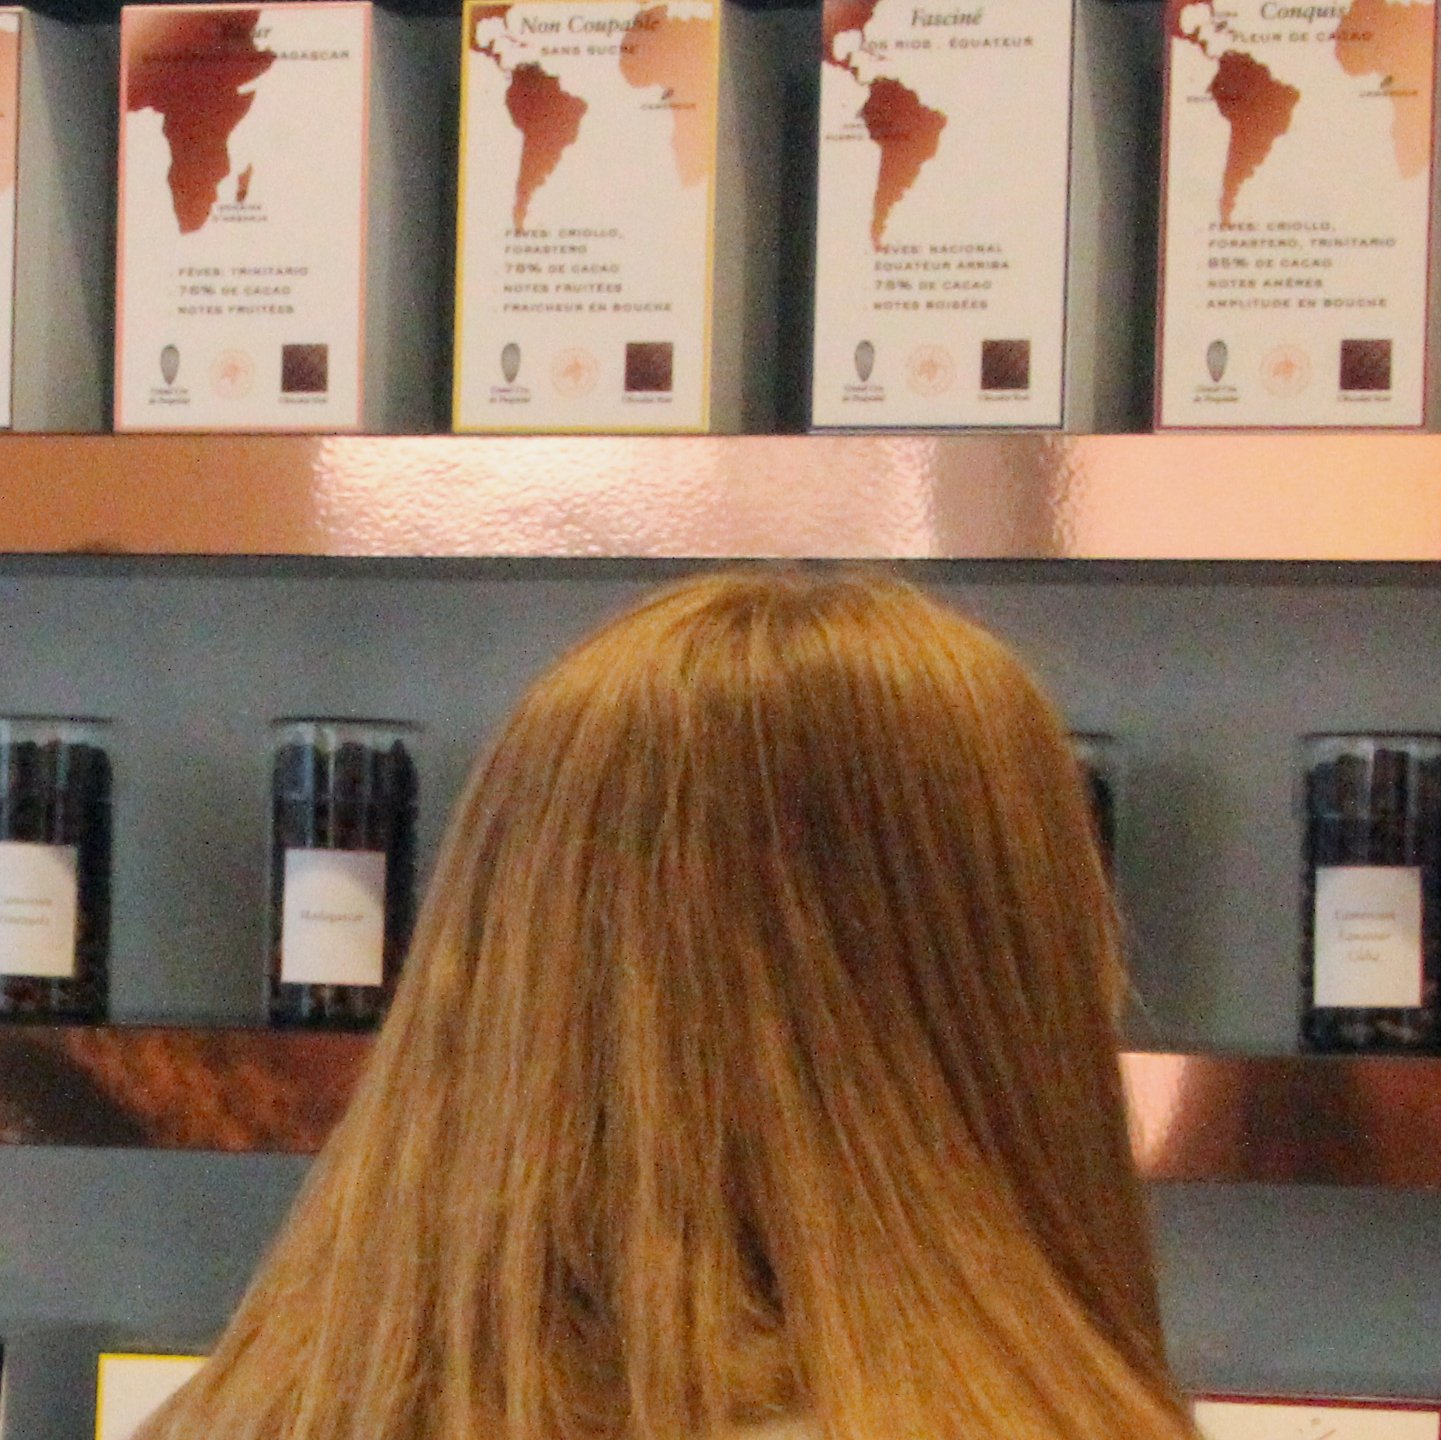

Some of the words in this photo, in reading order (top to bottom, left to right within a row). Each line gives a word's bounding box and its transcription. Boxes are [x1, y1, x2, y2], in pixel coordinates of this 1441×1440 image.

[910, 6, 985, 28] Fasciné
[1260, 2, 1349, 24] Conquis
[520, 16, 561, 35] Non
[568, 14, 661, 36] Coupable
[1231, 31, 1282, 43] FLEUR
[1288, 31, 1310, 42] DE
[540, 45, 582, 56] SANS
[1310, 237, 1397, 248] TRINITARIO
[503, 245, 588, 255] FORASTERO
[929, 243, 1004, 254] NACIONAL
[1254, 258, 1274, 268] DE
[1280, 258, 1334, 268] CACAO
[548, 264, 566, 274] DE
[571, 264, 621, 274] CACAO
[503, 283, 549, 293] NOTES
[918, 280, 937, 290] DE
[942, 280, 993, 290] CACAO
[1207, 279, 1257, 289] NOTES
[221, 286, 239, 296] DE
[244, 285, 292, 296] CACAO
[588, 302, 607, 312] EN
[613, 302, 672, 312] BOUCHE
[873, 301, 920, 311] NOTES
[1206, 298, 1291, 309] AMPLITUDE
[1297, 298, 1316, 308] EN
[1323, 298, 1388, 308] BOUCHE
[178, 305, 223, 315] NOTES
